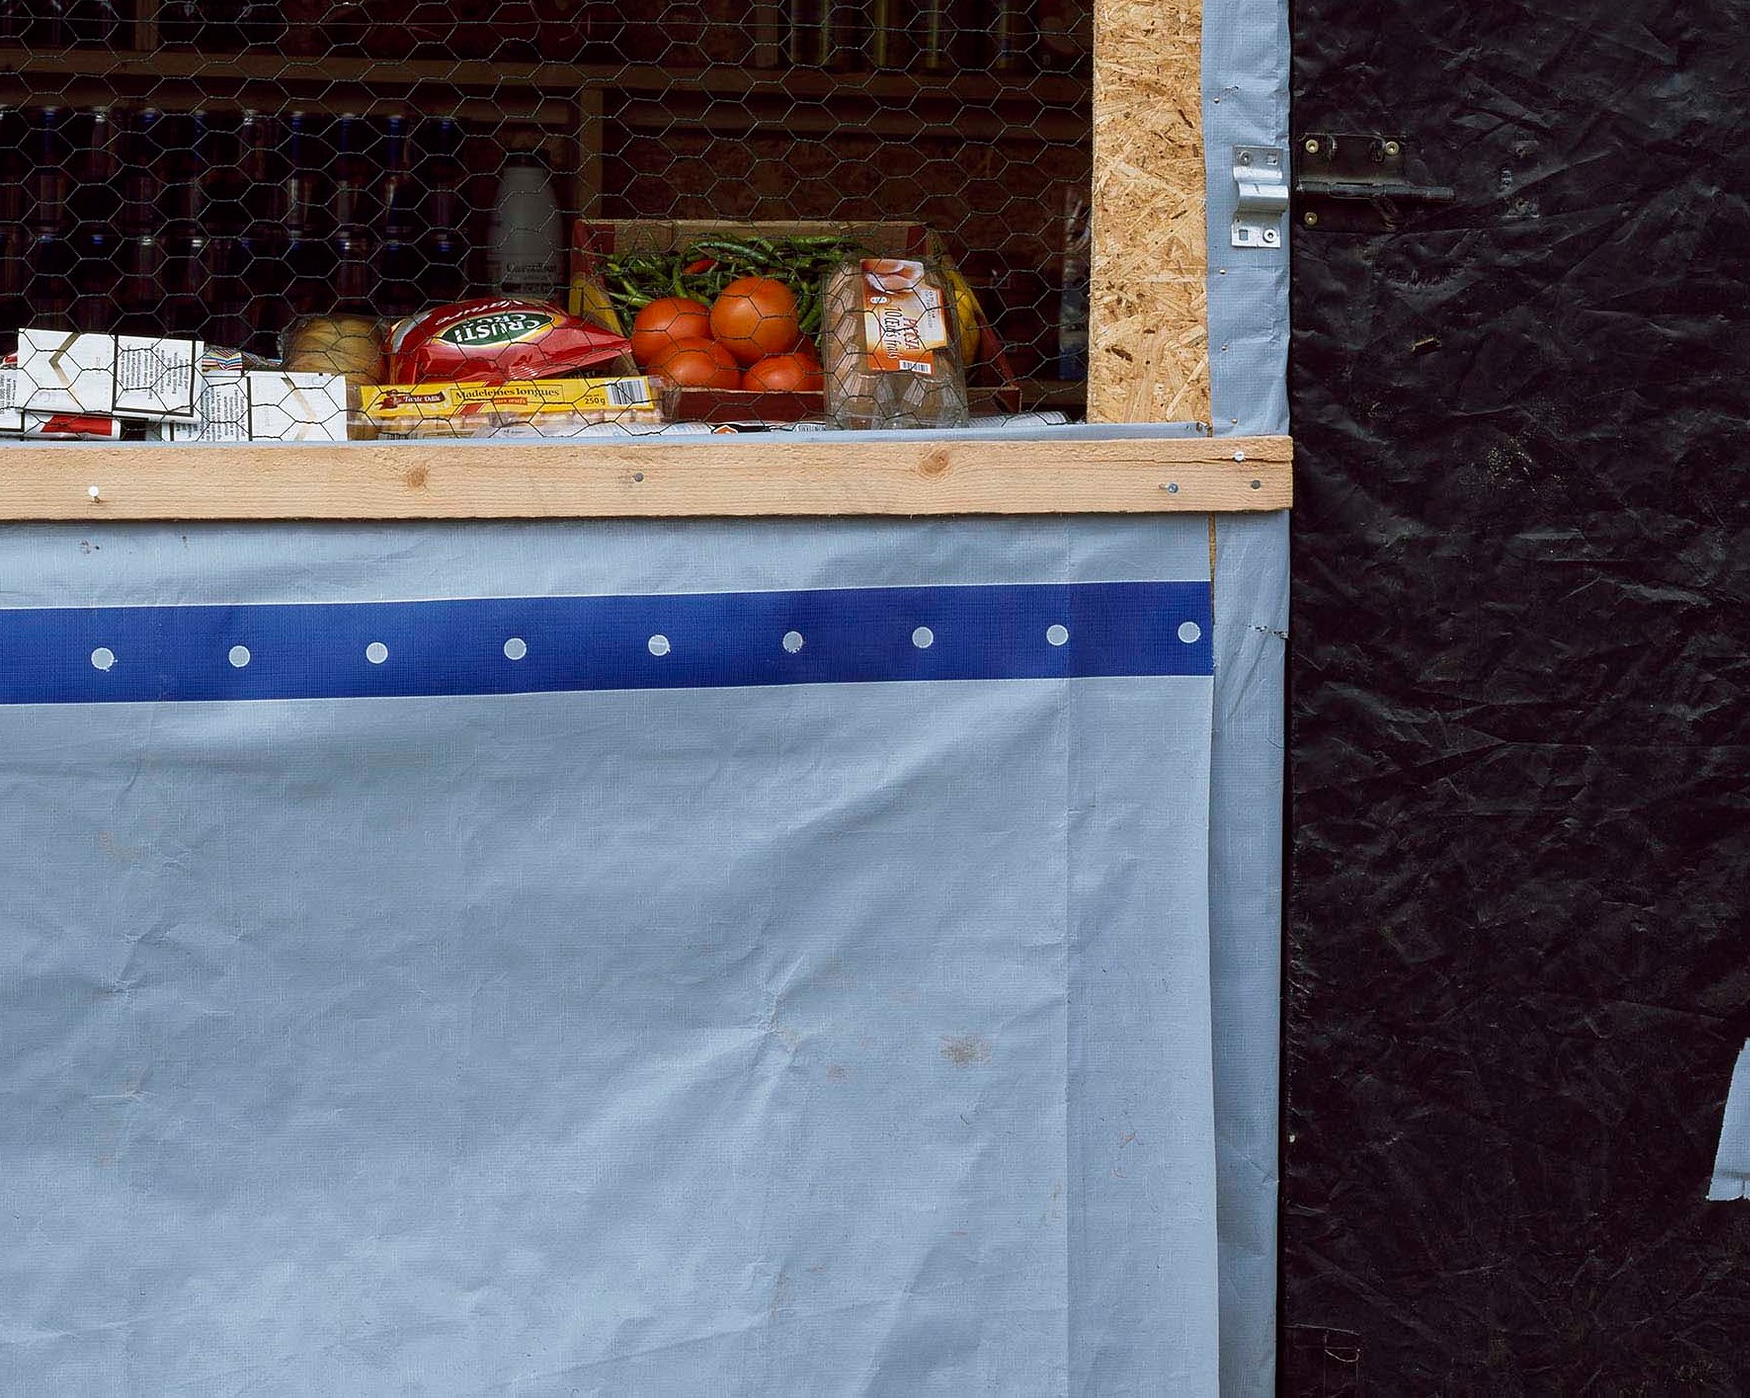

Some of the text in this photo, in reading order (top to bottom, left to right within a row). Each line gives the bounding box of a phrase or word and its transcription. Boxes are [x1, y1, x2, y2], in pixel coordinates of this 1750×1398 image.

[883, 306, 903, 318] 10
[453, 319, 541, 343] CRUSTI
[455, 385, 560, 400] Madeleines longues
[584, 397, 599, 406] 250
